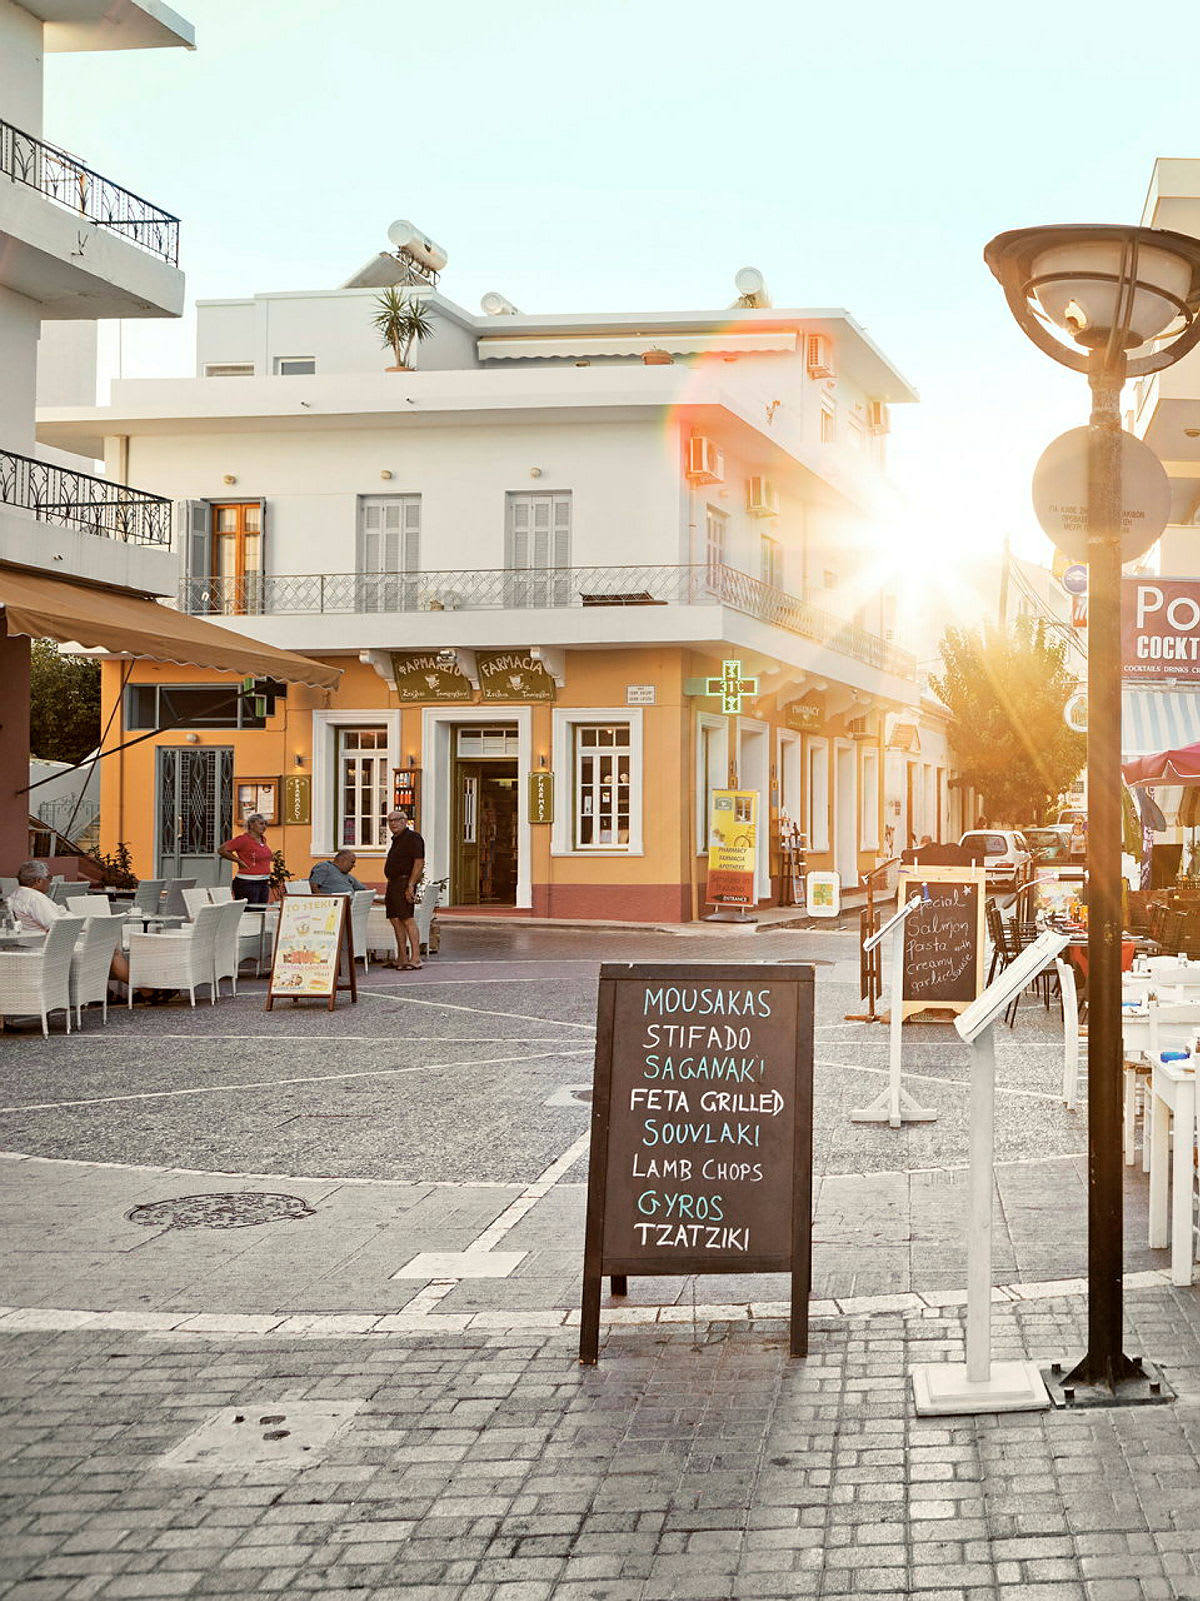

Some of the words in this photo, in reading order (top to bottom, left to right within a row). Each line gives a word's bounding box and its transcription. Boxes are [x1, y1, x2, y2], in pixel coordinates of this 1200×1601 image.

[481, 655, 544, 678] FARMACIA
[1123, 664, 1162, 673] COCKTAILS
[1163, 666, 1190, 674] DRINKS
[718, 846, 748, 854] PHARMACY
[907, 914, 970, 939] Salmon
[906, 956, 954, 977] creamy
[643, 988, 772, 1018] MOUSAKAS
[643, 1024, 751, 1052] STIFADO
[643, 1054, 765, 1083] SAGANAKI
[630, 1088, 690, 1113] FETA
[700, 1088, 785, 1117] GRILLED
[643, 1118, 760, 1148] SOUVLAKI
[631, 1153, 692, 1181] LAMB
[702, 1158, 764, 1182] CHOPS
[637, 1190, 725, 1222] GYROS
[633, 1222, 750, 1252] TZATZIKI
